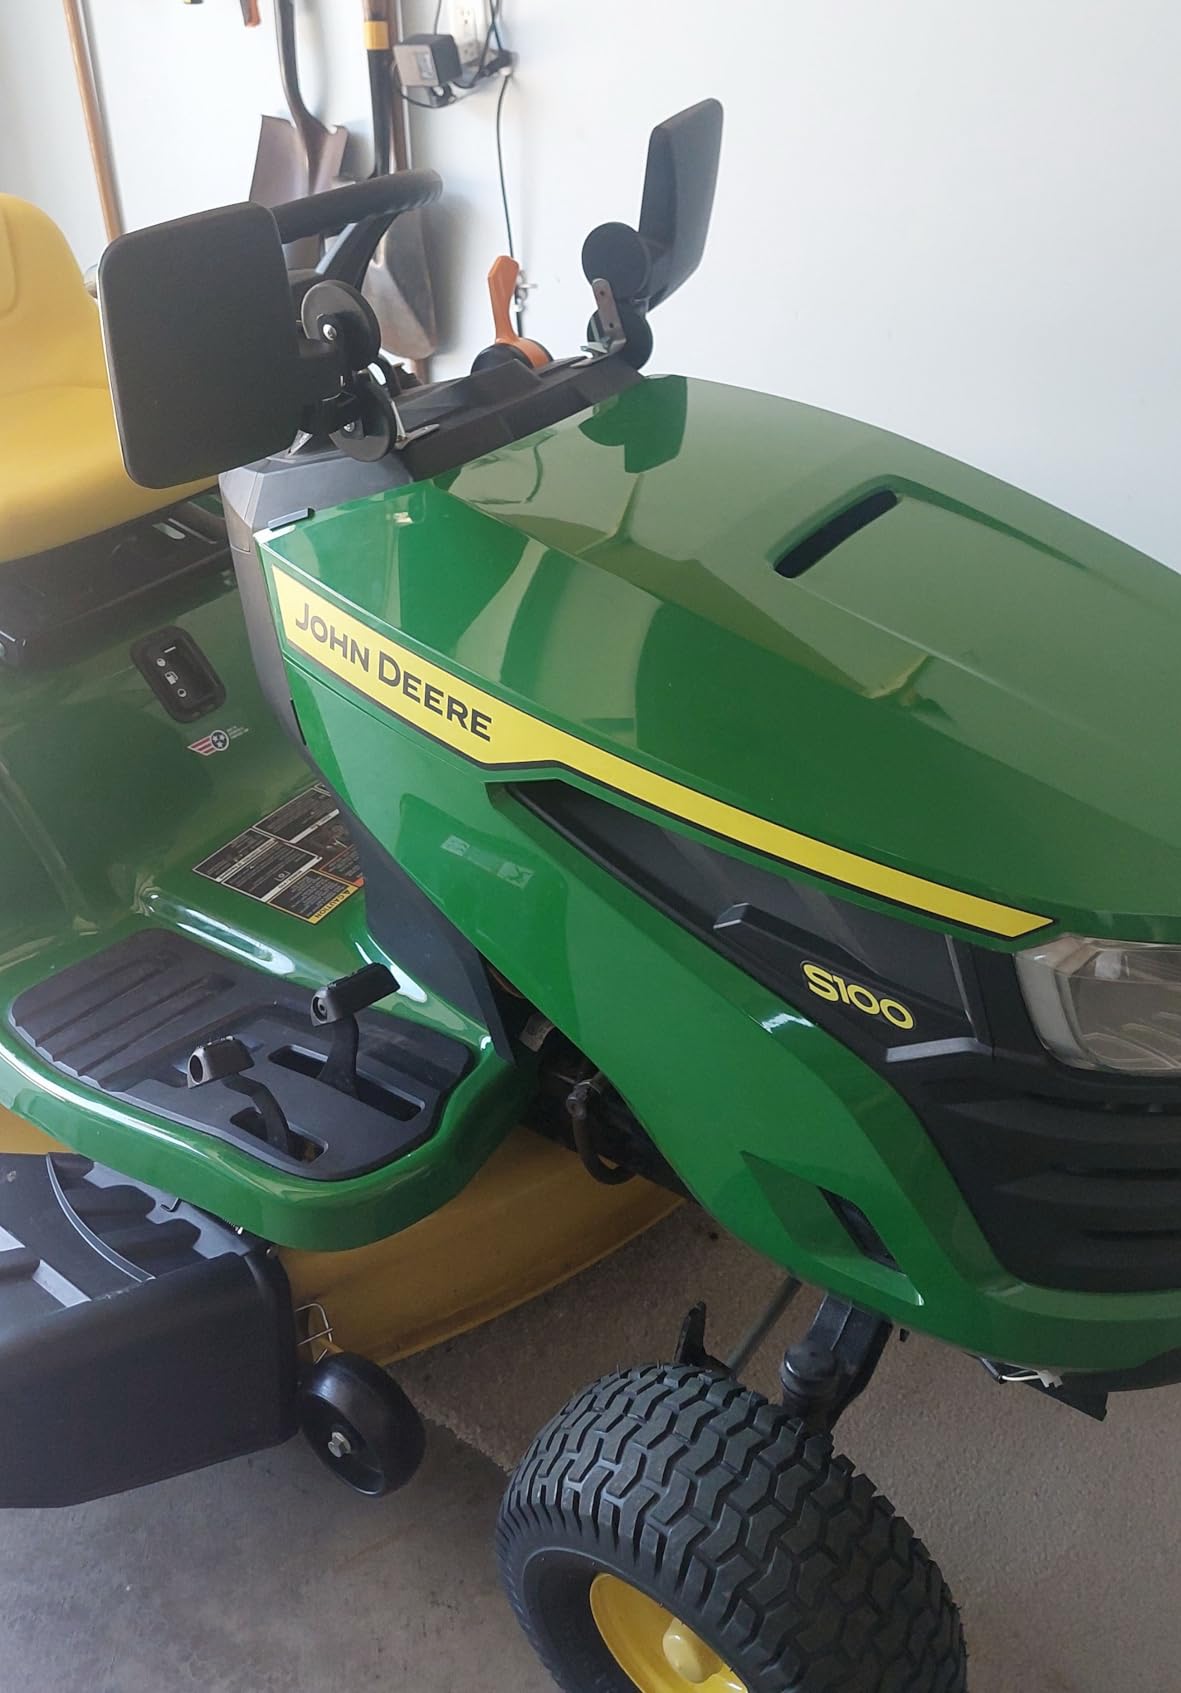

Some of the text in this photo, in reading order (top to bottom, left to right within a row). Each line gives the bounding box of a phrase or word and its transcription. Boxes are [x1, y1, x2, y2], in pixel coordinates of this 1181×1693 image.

[295, 603, 492, 742] JOHN DEERE
[314, 894, 345, 919] CAUTION
[802, 963, 914, 1030] S100
